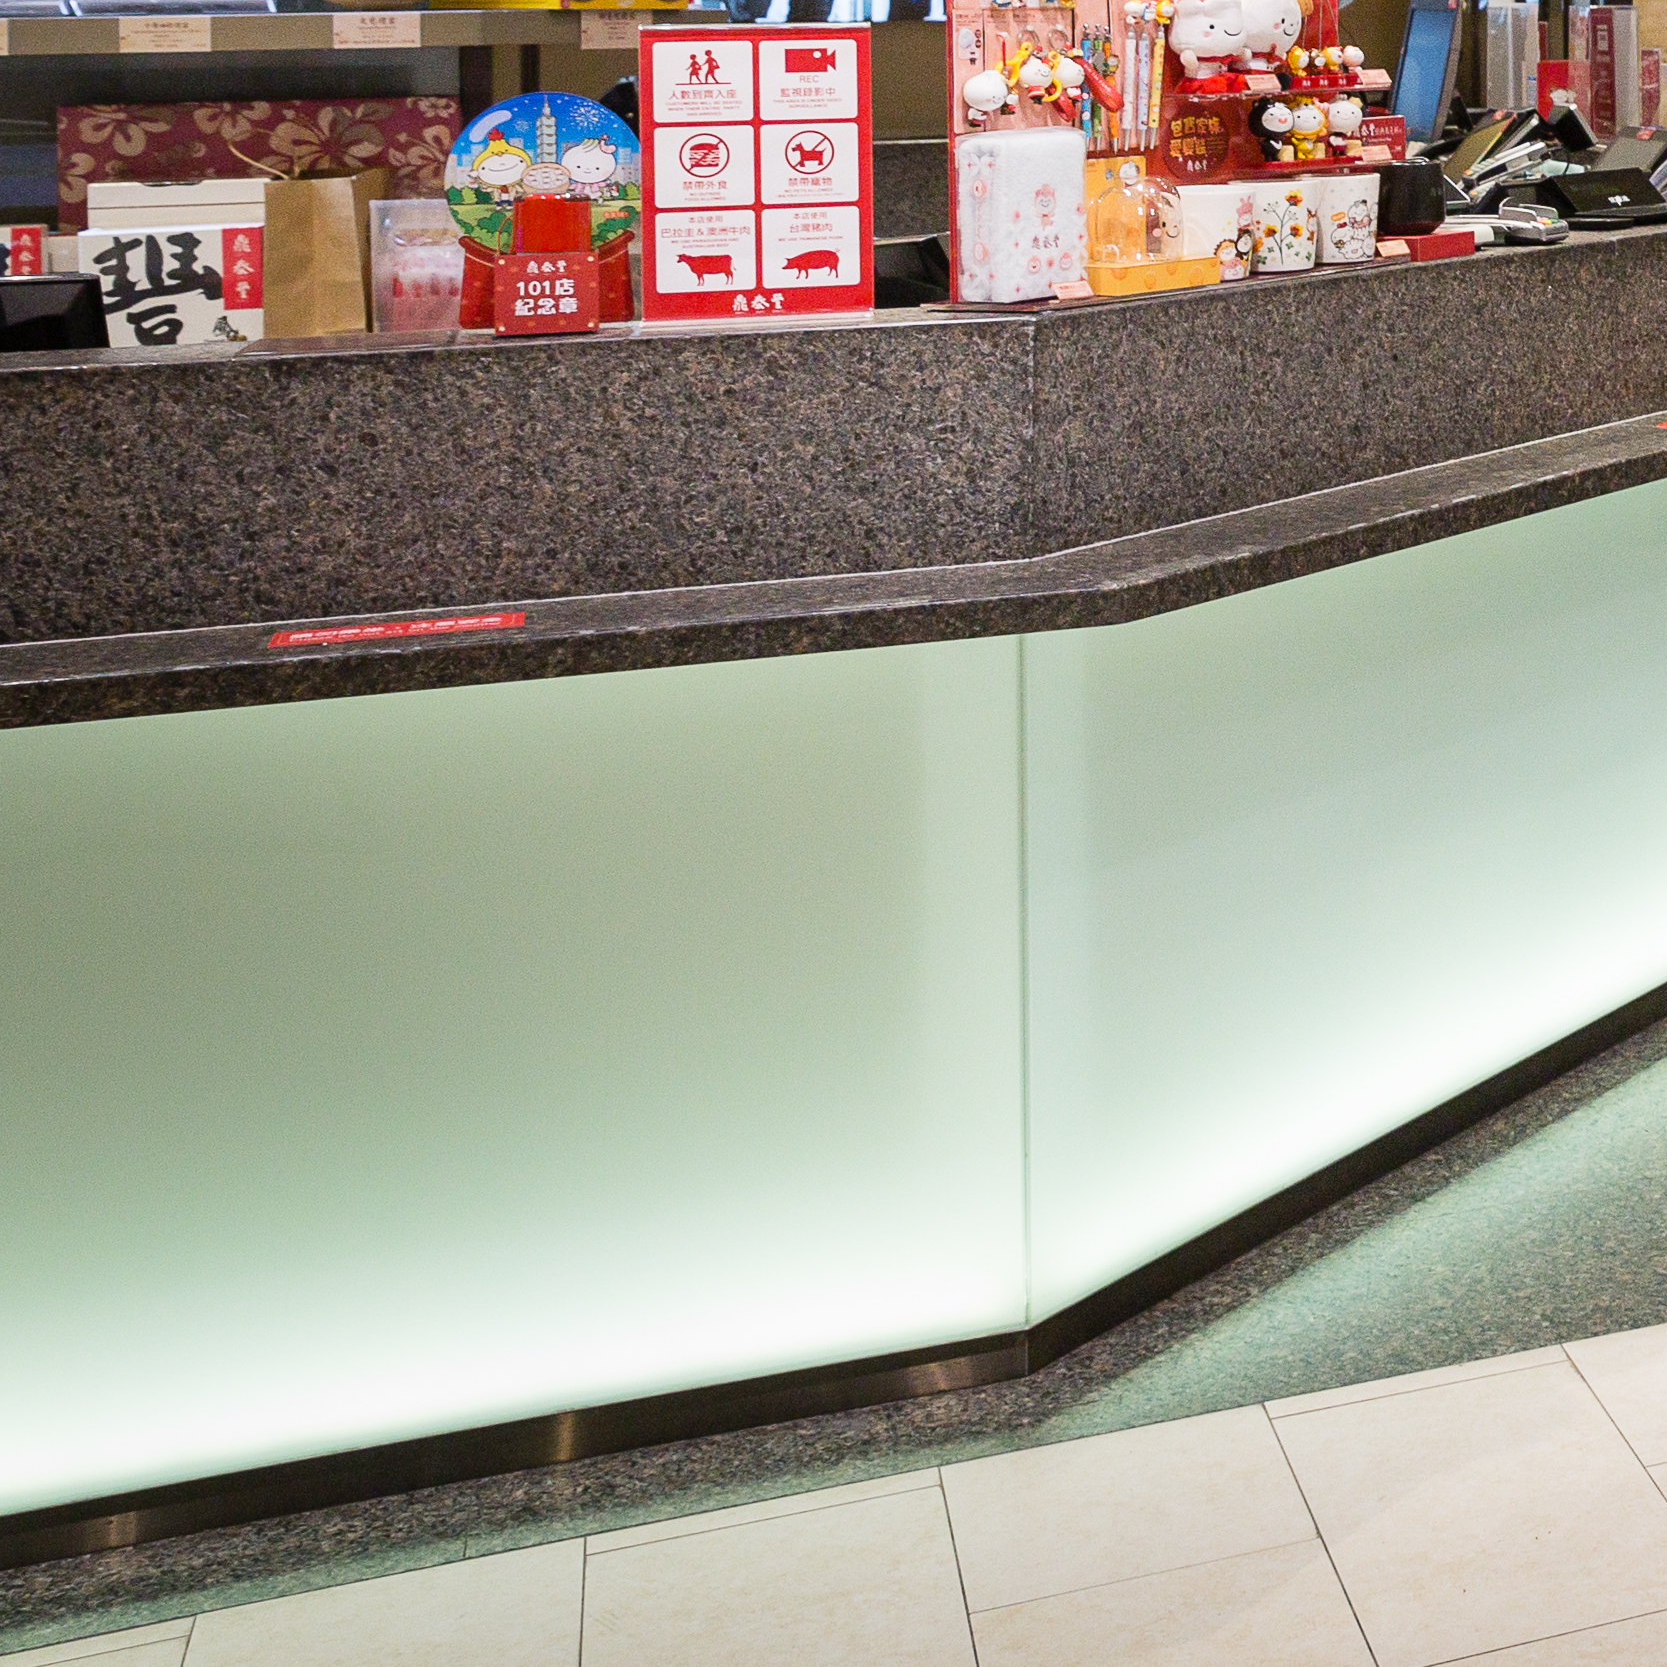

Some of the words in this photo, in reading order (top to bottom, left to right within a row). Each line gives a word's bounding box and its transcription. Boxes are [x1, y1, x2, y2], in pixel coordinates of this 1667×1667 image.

[799, 75, 820, 83] REC
[793, 212, 828, 220] 本店使用
[232, 234, 256, 300] 鼎泰豐
[526, 260, 568, 274] 鼎泰豐
[516, 279, 575, 296] 101店
[514, 297, 579, 316] 紀念章
[732, 293, 785, 312] 鼎泰豐
